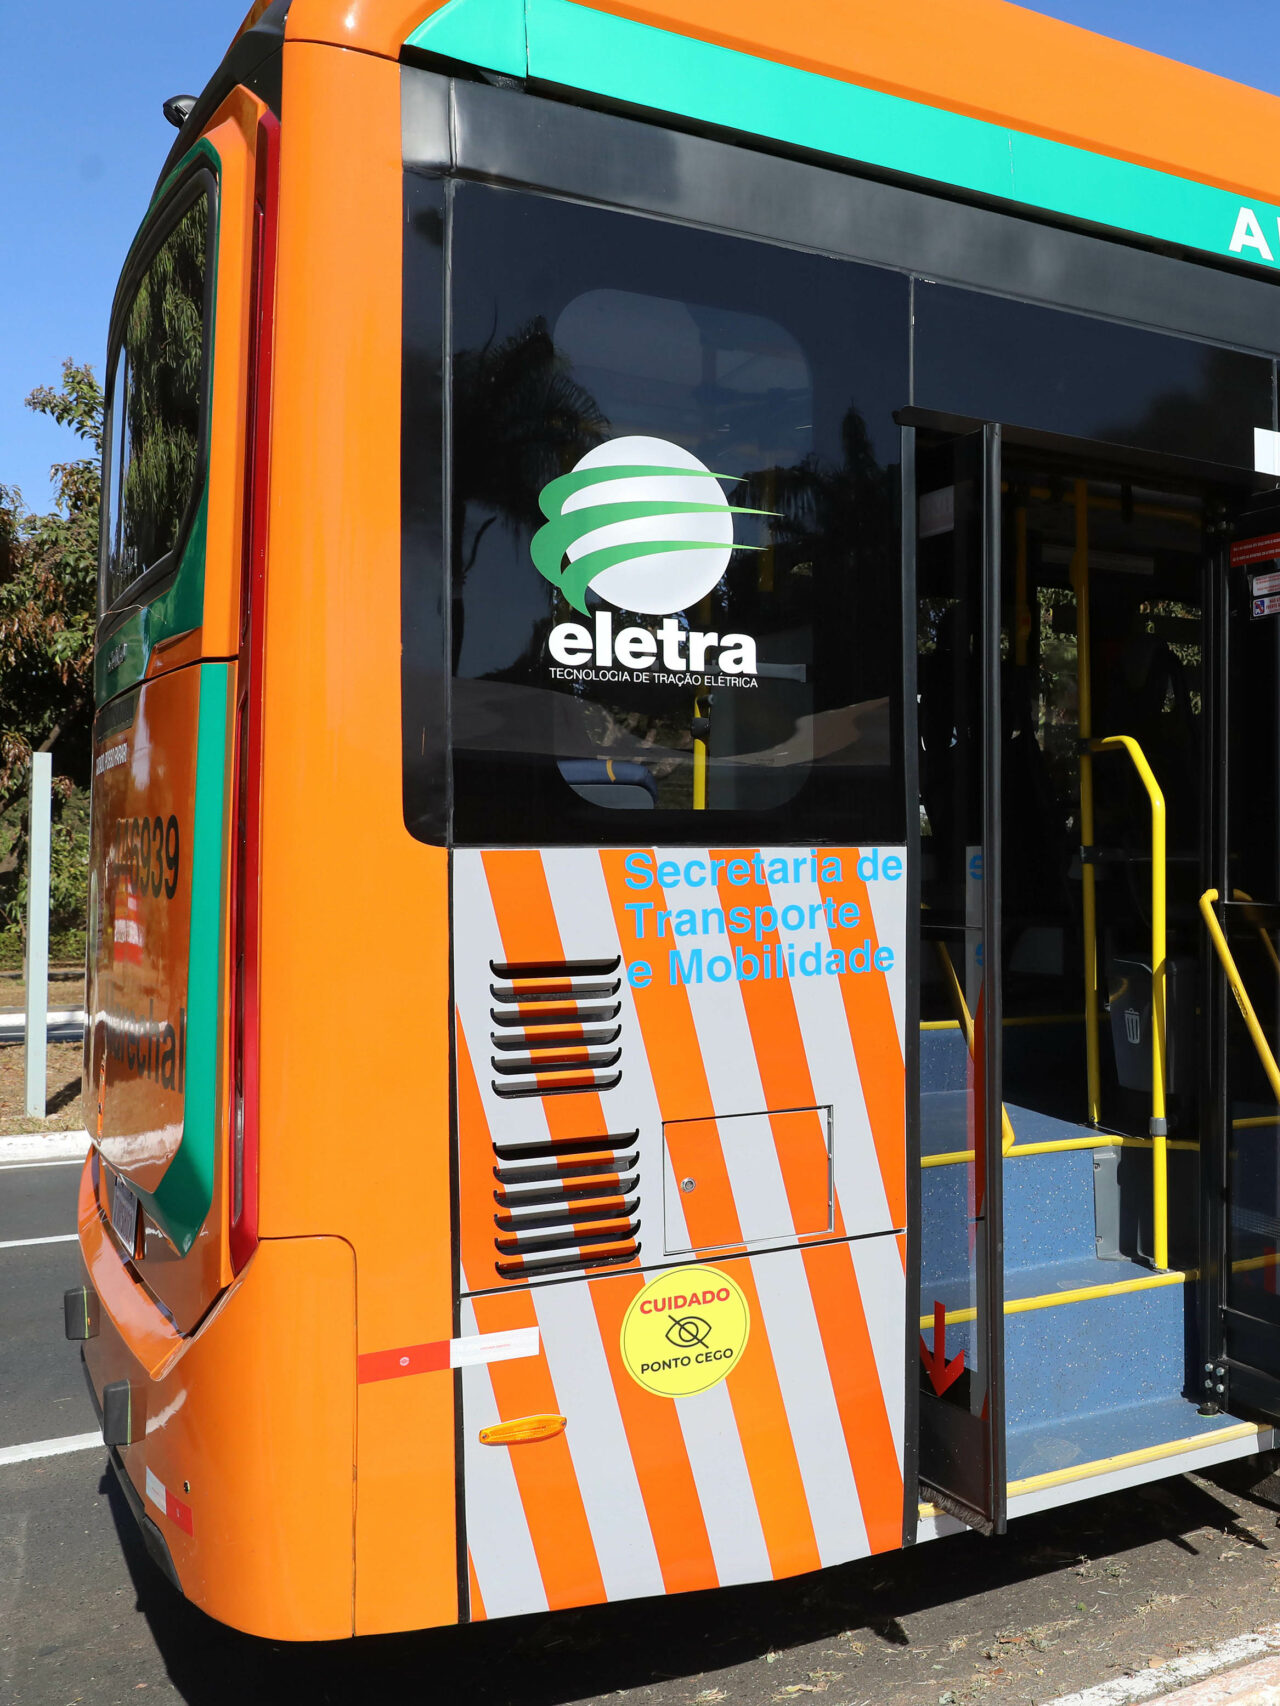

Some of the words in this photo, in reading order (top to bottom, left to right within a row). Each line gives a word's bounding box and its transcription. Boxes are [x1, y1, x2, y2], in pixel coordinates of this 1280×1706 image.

[548, 610, 758, 675] eletra
[549, 667, 631, 683] TECNOLOGIA
[633, 671, 650, 684] DE
[653, 672, 701, 688] TRAÇÃO
[704, 672, 758, 689] ELÉTRICA
[624, 849, 843, 890] Secretaria
[857, 848, 903, 882] de
[625, 896, 861, 943] Transporte
[627, 958, 652, 988] e
[669, 939, 895, 986] Mobilidade
[640, 1287, 731, 1315] CUIDADO
[641, 1356, 691, 1375] PONTO
[695, 1348, 734, 1364] CEGO
